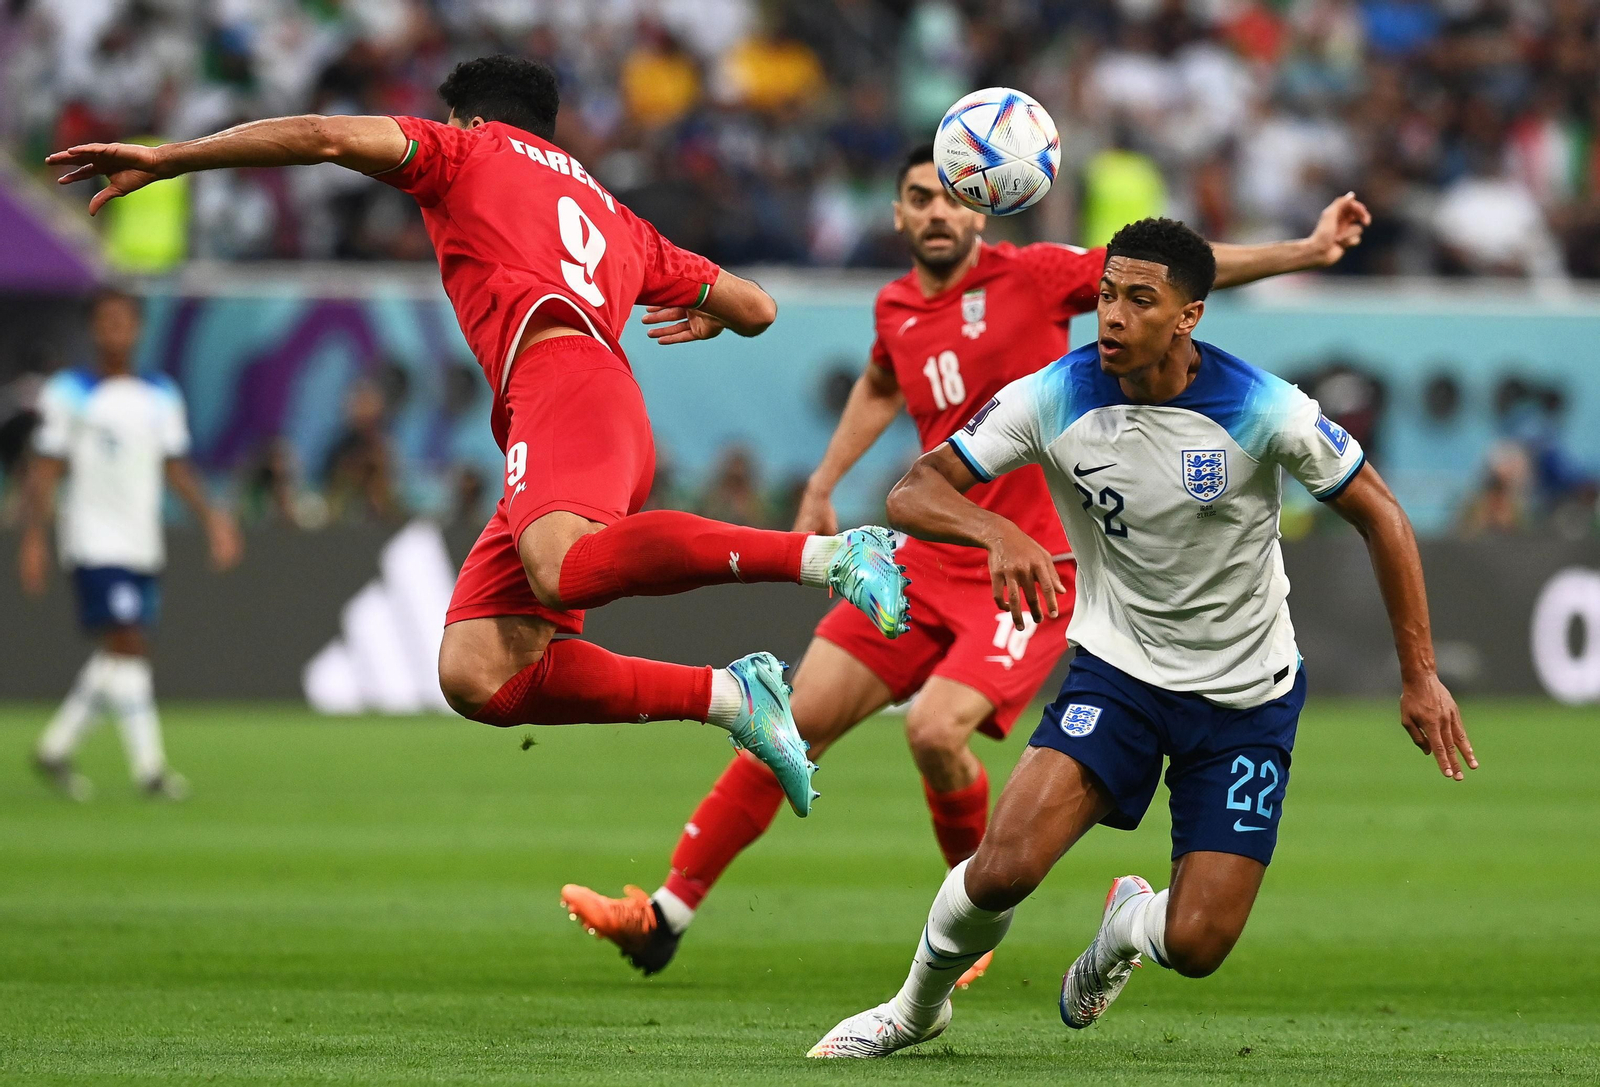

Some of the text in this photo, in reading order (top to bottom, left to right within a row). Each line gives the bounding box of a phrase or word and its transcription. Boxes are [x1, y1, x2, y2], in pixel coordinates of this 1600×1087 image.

[557, 195, 607, 307] 9
[922, 350, 966, 411] 18
[507, 441, 528, 486] 9
[992, 610, 1038, 661] 18
[1226, 754, 1279, 819] 22
